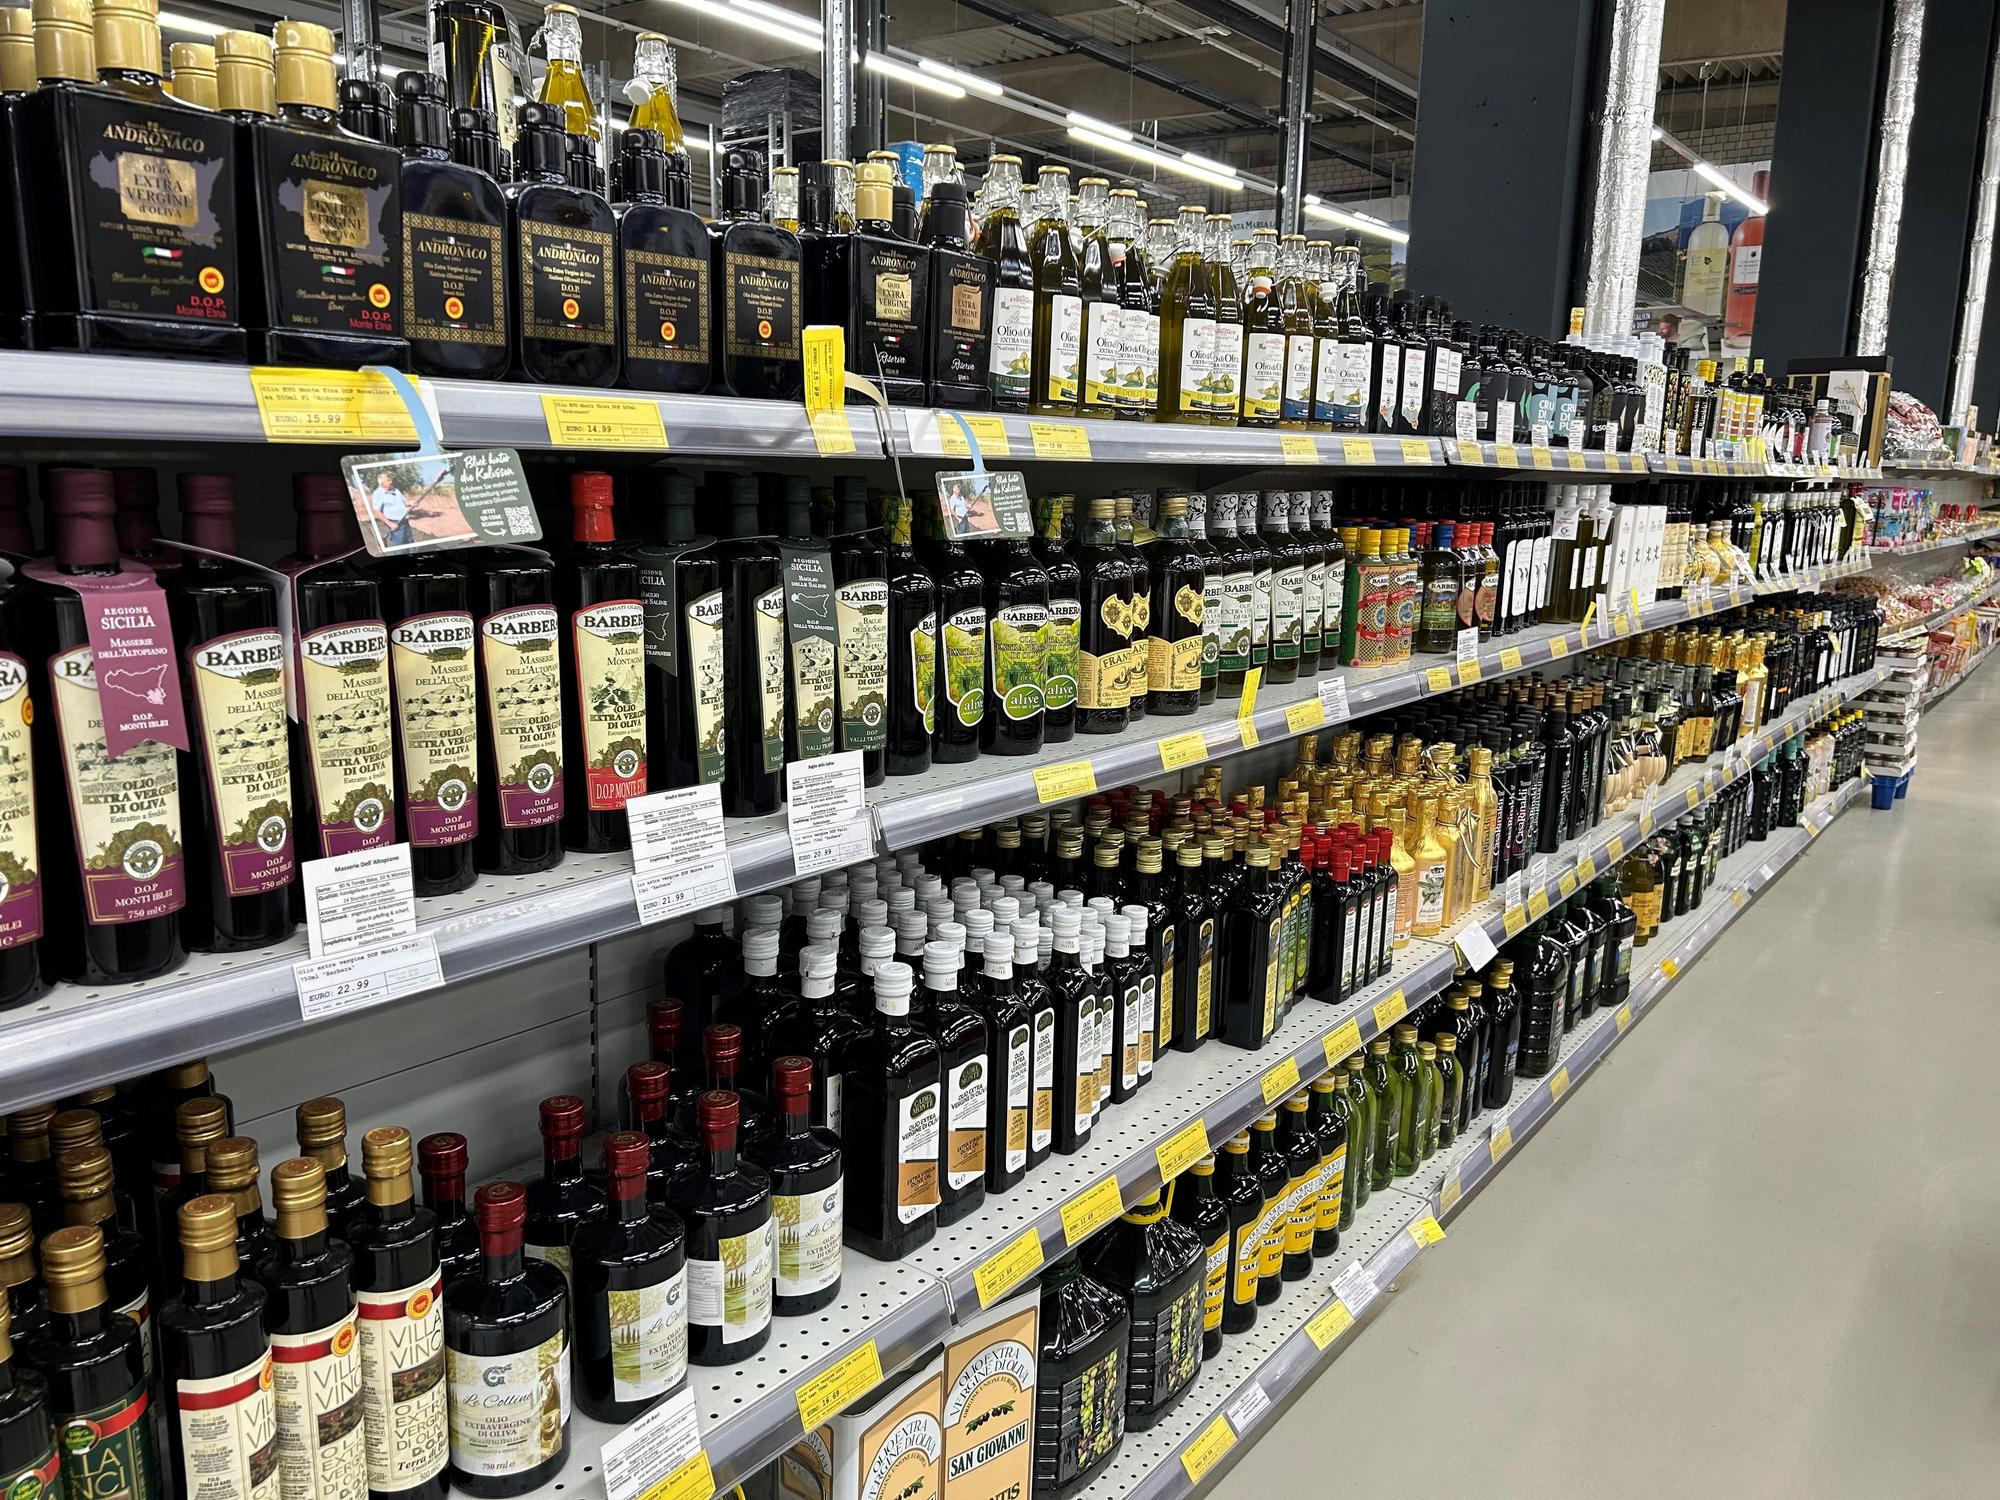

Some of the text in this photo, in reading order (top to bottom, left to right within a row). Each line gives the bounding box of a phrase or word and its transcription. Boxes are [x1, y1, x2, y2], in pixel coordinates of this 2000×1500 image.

[143, 163, 172, 175] OLIO
[134, 174, 183, 192] EXTRA
[126, 187, 192, 208] VERGINE
[417, 240, 487, 262] ANDRONACO
[537, 247, 600, 266] ANDRONACO
[870, 255, 916, 271] ANDRONACO
[443, 281, 464, 291] D.O.P.
[640, 274, 696, 290] ANDRONACO
[739, 274, 789, 290] ANDRONACO
[887, 282, 901, 290] OLIO
[561, 283, 581, 294] D.O.P.
[882, 290, 905, 300] EXTRA
[191, 295, 226, 309] D.O.P.
[879, 298, 909, 309] VERGINE
[957, 300, 976, 310] EXTRA
[176, 304, 227, 319] Monte Etna
[361, 309, 392, 323] D.O.P.
[659, 308, 677, 317] D.O.P.
[757, 307, 773, 316] D.O.P.
[954, 307, 979, 318] VERGINE
[349, 318, 392, 332] Monte Etna
[997, 325, 1018, 337] Olio
[1539, 399, 1554, 411] CRU
[1560, 403, 1577, 413] CRU
[274, 413, 341, 424] EURO: 15.99
[1538, 410, 1547, 419] DI
[1560, 413, 1570, 422] DI
[587, 425, 612, 433] 14.99
[790, 562, 823, 573] SICILIA
[104, 607, 149, 616] REGIONE
[1003, 611, 1048, 622] BARBERA
[100, 615, 156, 630] SICILIA
[413, 616, 444, 629] PREMIATI
[584, 613, 644, 628] BARBER
[1047, 684, 1073, 696] alive
[1010, 693, 1039, 706] alive
[616, 704, 636, 713] OLIO
[133, 713, 154, 722] D.O.P.
[529, 715, 550, 726] OLIO
[119, 719, 169, 731] MONTI IBLEI
[608, 719, 641, 730] DI OLIVA
[439, 728, 463, 738] OLIO
[519, 731, 556, 743] DI OLIVA
[353, 743, 378, 754] OLIO
[408, 737, 447, 748] EXTRA
[429, 744, 470, 757] DI OLIVA
[256, 760, 281, 771] OLIO
[343, 762, 386, 776] DI OLIVA
[122, 777, 154, 791] OLIO
[246, 779, 287, 794] DI OLIVA
[616, 780, 635, 798] MONTE
[83, 791, 135, 806] EXTRA
[109, 798, 166, 815] DI OLIVA
[521, 805, 545, 816] MONTI
[110, 812, 141, 824] Estratto
[148, 808, 168, 819] freddo
[1516, 788, 1528, 844] CasaRinaldi
[430, 821, 472, 834] MONTI IBLEI
[334, 862, 359, 873] Masserie
[115, 888, 173, 908] MONTI IBLEI
[662, 892, 685, 906] 21.99
[339, 955, 364, 966] vergine
[309, 979, 370, 1003] EURO: 22.99
[1014, 1050, 1024, 1059] OLIO
[1012, 1056, 1025, 1067] EXTRA
[958, 1084, 983, 1101] OLIO EXTRA
[908, 1113, 936, 1132] OLIO EXTRA
[902, 1126, 922, 1142] VERGINE
[907, 1174, 921, 1185] EXTRA
[910, 1179, 923, 1188] OLIVE
[389, 1307, 442, 1348] VILLA
[958, 1346, 1020, 1388] OLIO EXTRA
[950, 1362, 993, 1417] VERGINE
[1006, 1361, 1029, 1385] OLIVA
[463, 1393, 480, 1407] Le
[822, 1389, 841, 1407] 16.69
[464, 1416, 532, 1431] EXTRAVERGINE
[485, 1416, 508, 1424] OLIO
[478, 1429, 517, 1438] DI OLIVA
[397, 1439, 412, 1451] DI
[873, 1420, 928, 1473] OLIO EXTRA
[914, 1434, 937, 1455] OLIVA
[950, 1423, 1026, 1477] SAN GIOVANNI
[397, 1449, 437, 1471] Terra di
[482, 1462, 495, 1471] 750
[420, 1469, 431, 1482] 500
